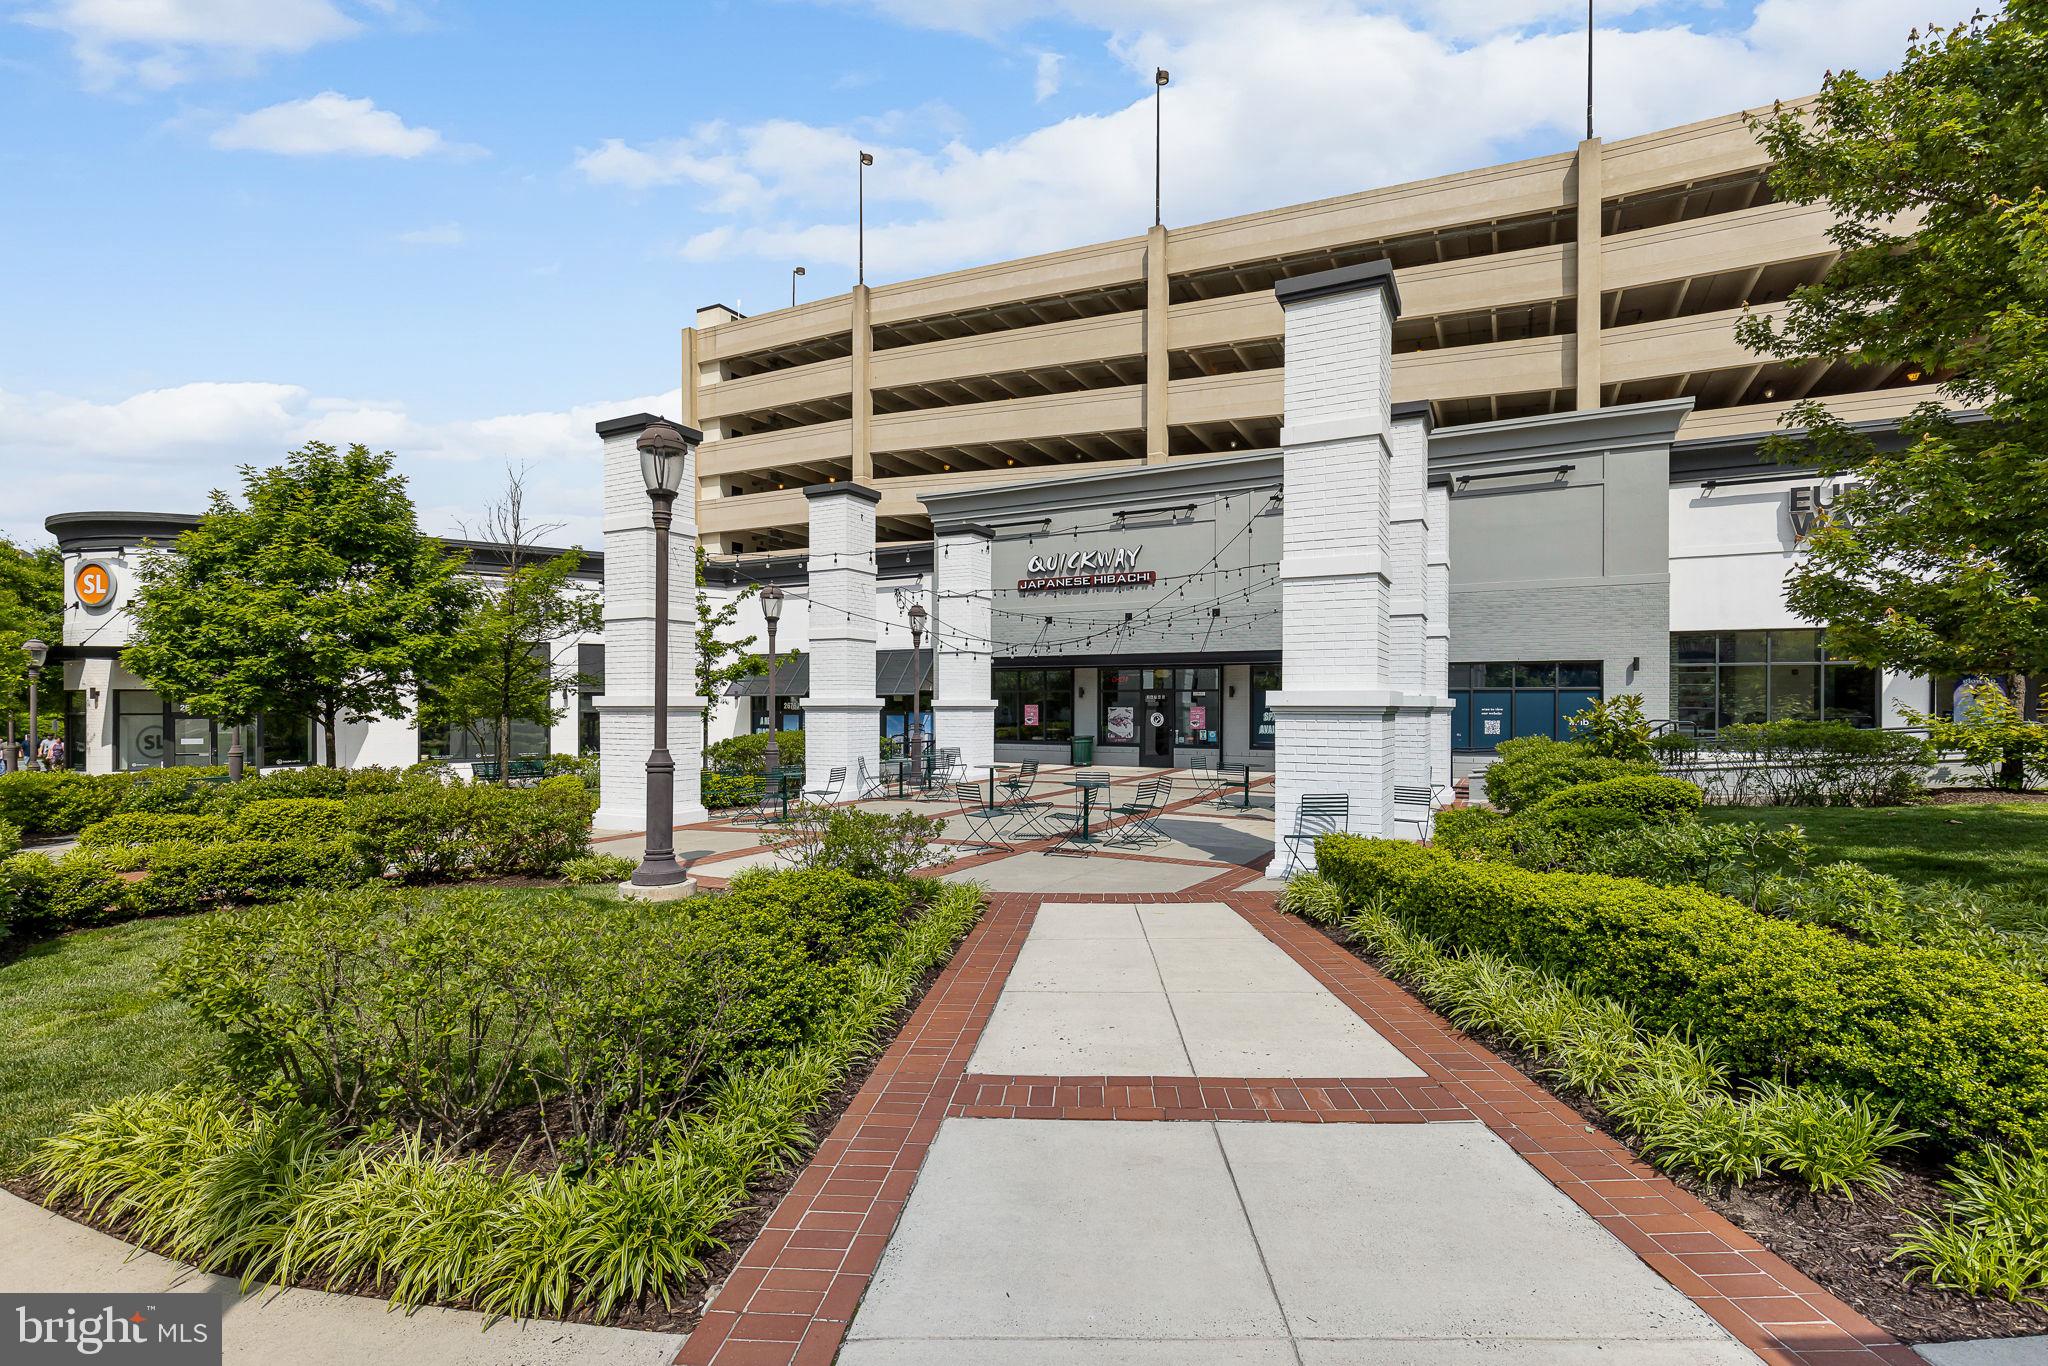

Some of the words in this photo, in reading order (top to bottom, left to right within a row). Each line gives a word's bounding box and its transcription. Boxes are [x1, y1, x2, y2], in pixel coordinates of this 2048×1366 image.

[1027, 545, 1143, 573] QUICKWAY
[83, 574, 106, 595] SL
[1020, 576, 1091, 590] JAPANESE
[1093, 572, 1150, 585] HIBACHI
